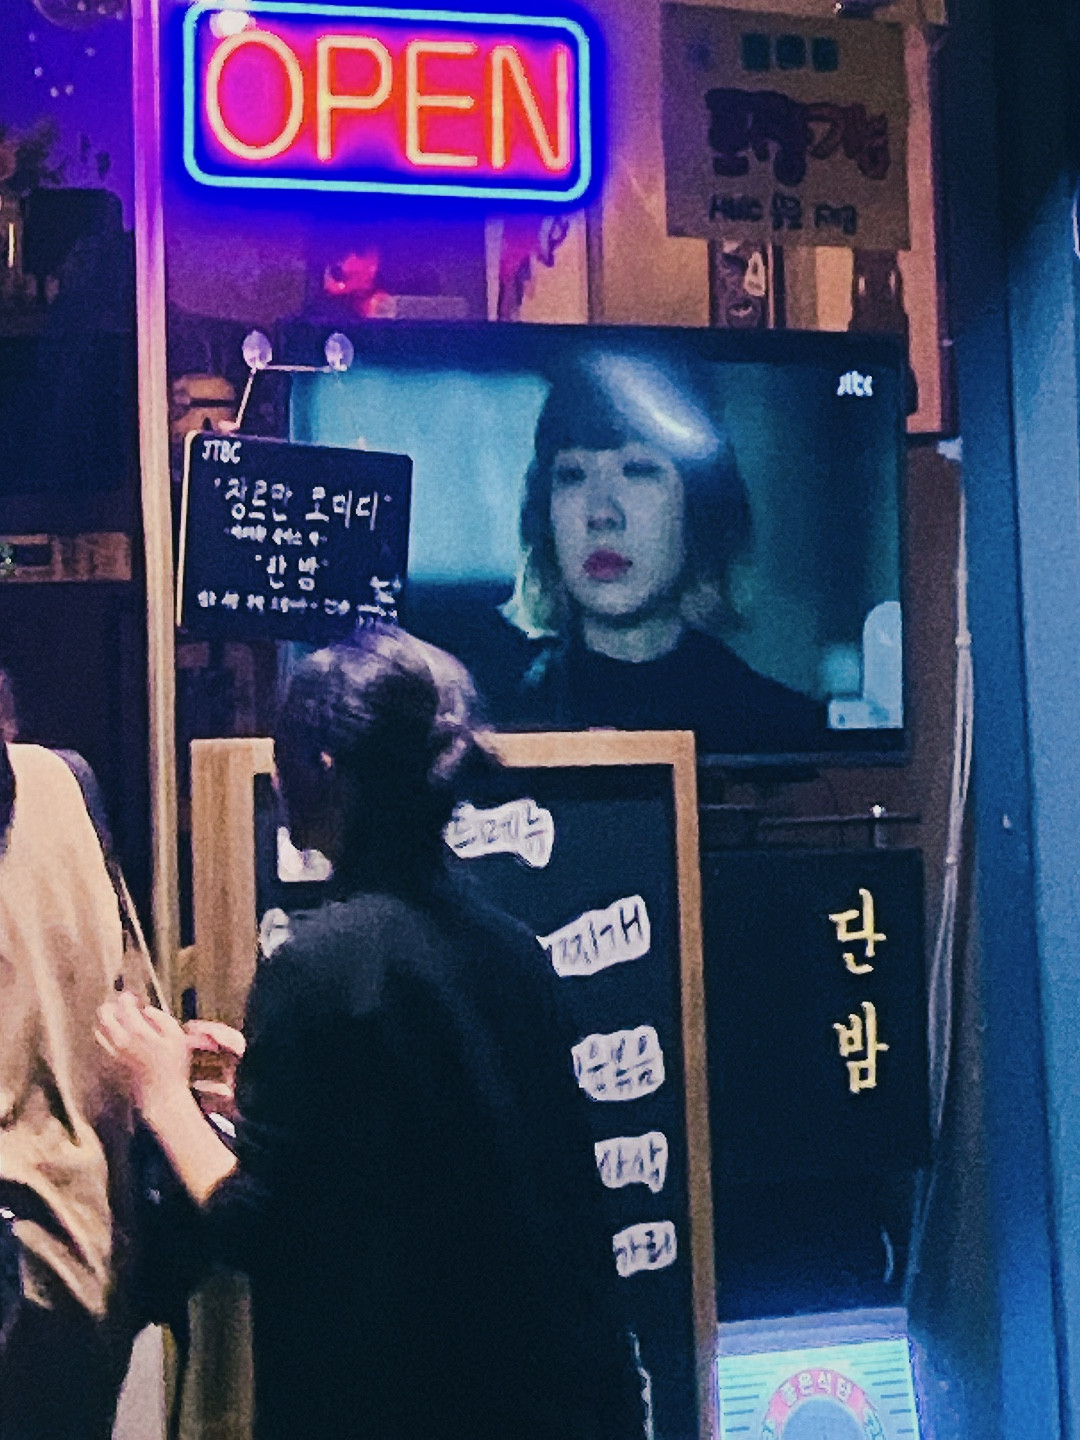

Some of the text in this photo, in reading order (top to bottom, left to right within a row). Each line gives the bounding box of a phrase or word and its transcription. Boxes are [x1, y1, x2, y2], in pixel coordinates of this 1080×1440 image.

[206, 29, 572, 171] OPEN
[201, 439, 242, 465] JTBC
[828, 887, 890, 1094] 단밤
